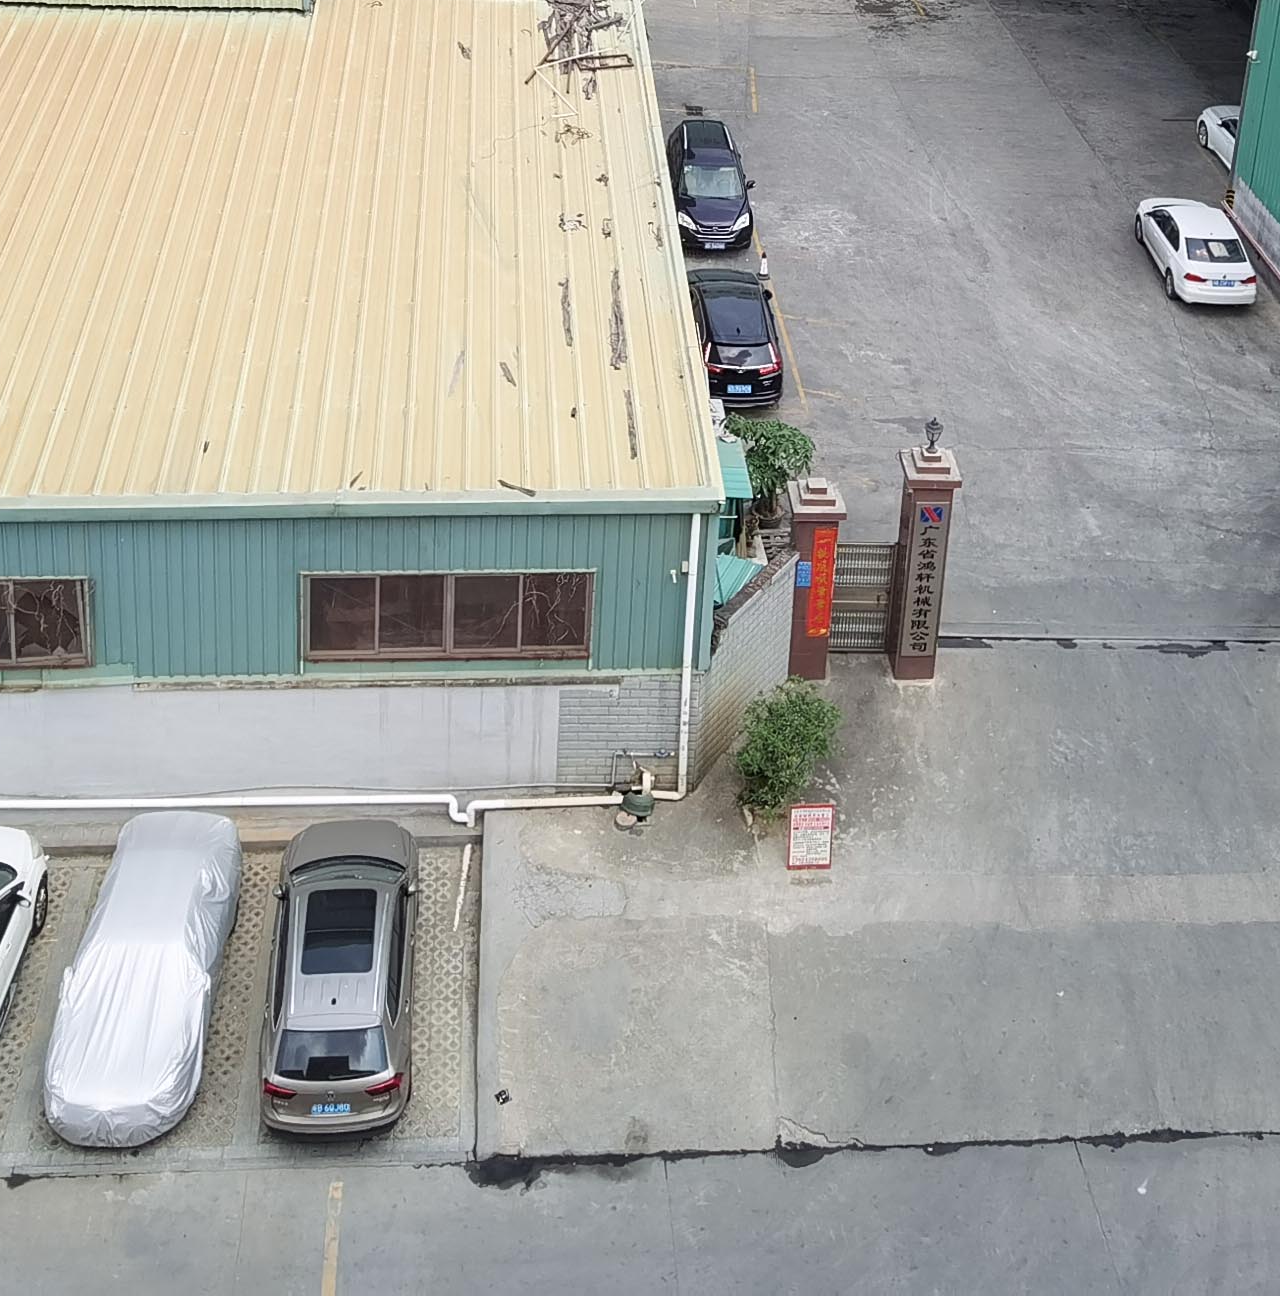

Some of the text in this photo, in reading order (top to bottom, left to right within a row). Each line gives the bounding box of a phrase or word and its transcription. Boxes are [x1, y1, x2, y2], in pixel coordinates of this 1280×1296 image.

[909, 525, 940, 652] 广东省鸿轩机械有限公司
